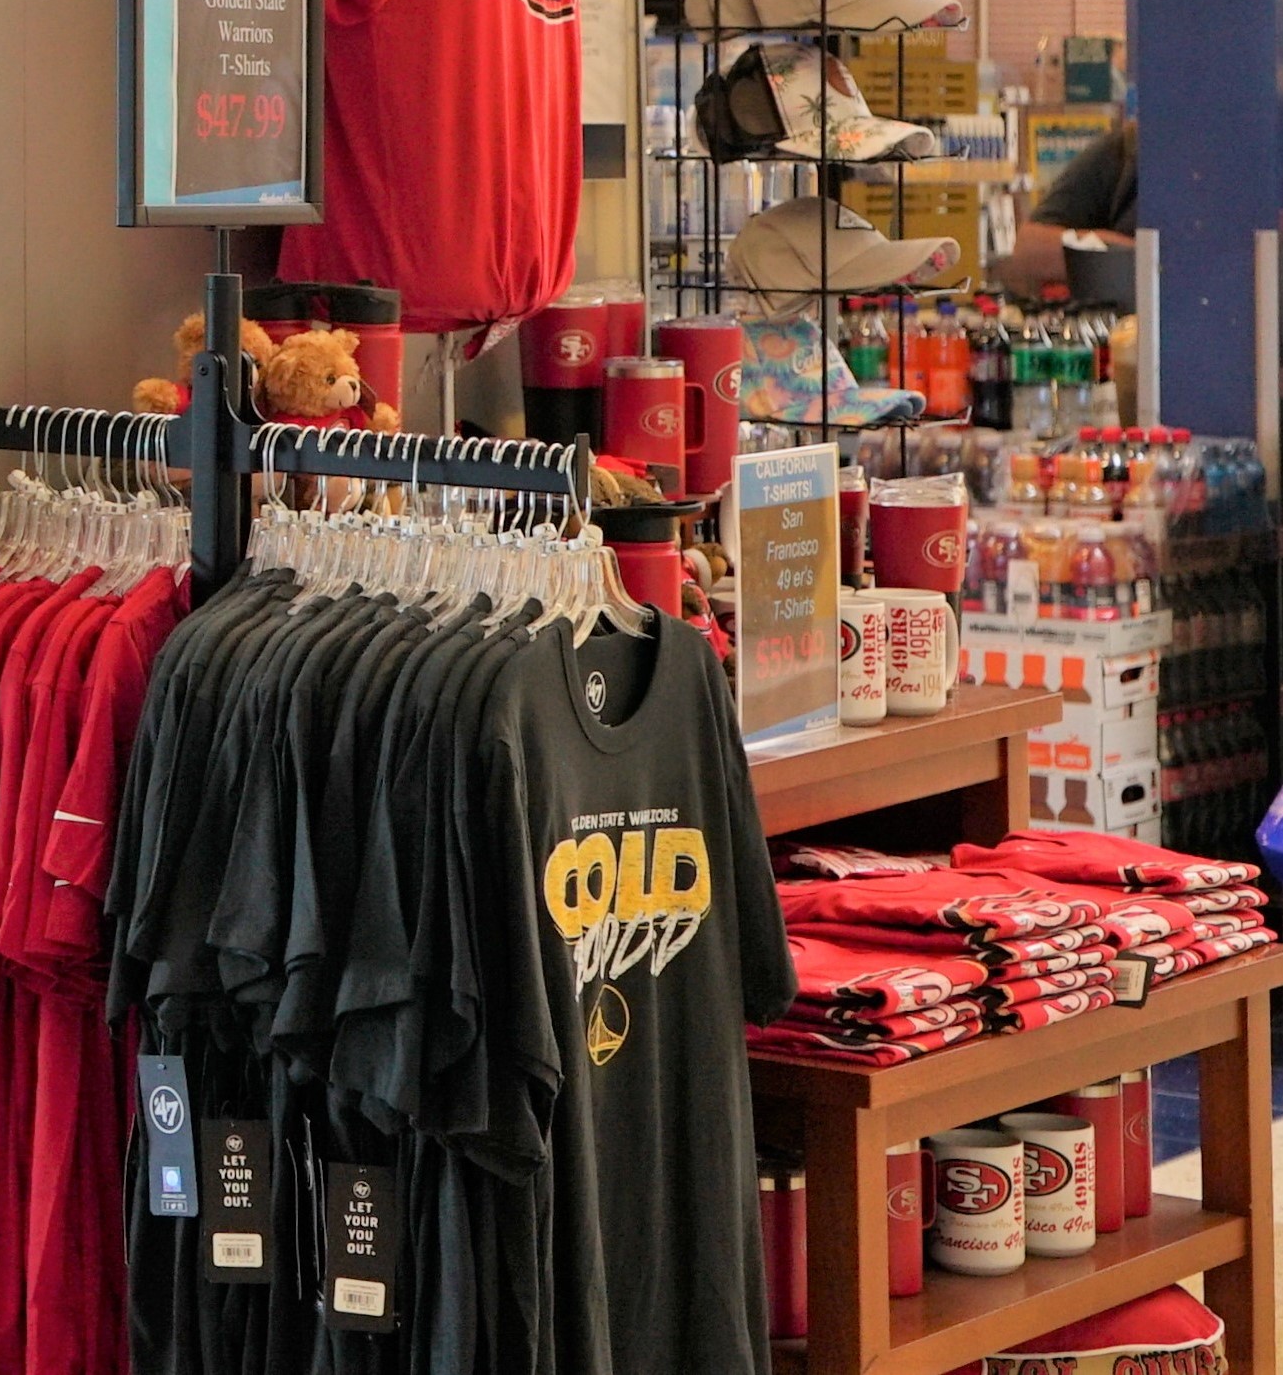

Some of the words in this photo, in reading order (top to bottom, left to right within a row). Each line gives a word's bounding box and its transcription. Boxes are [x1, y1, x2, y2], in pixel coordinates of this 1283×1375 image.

[218, 19, 275, 45] Warriors
[219, 53, 273, 78] T-Shirts
[195, 90, 286, 143] $47.99
[755, 455, 818, 480] CALIFORNIA
[762, 479, 813, 504] T-SHIRTS!
[781, 507, 803, 530] San
[766, 537, 819, 563] Francisco
[773, 598, 816, 621] T-Shirts
[890, 607, 908, 674] 49ERS
[909, 608, 932, 660] 49ERS
[753, 630, 826, 679] $59.99
[862, 613, 876, 680] 49ERS
[598, 811, 625, 828] STATE
[223, 1155, 247, 1167] LET
[218, 1168, 253, 1181] YOUR
[1073, 1141, 1088, 1211] 49ERS
[223, 1181, 249, 1194] YOU
[945, 1166, 1000, 1209] SF
[223, 1196, 252, 1208] OUT.
[349, 1201, 373, 1214] LET
[343, 1215, 379, 1228] YOUR
[347, 1229, 374, 1242] YOU
[936, 1232, 999, 1252] rancisco
[346, 1243, 376, 1256] OUT.
